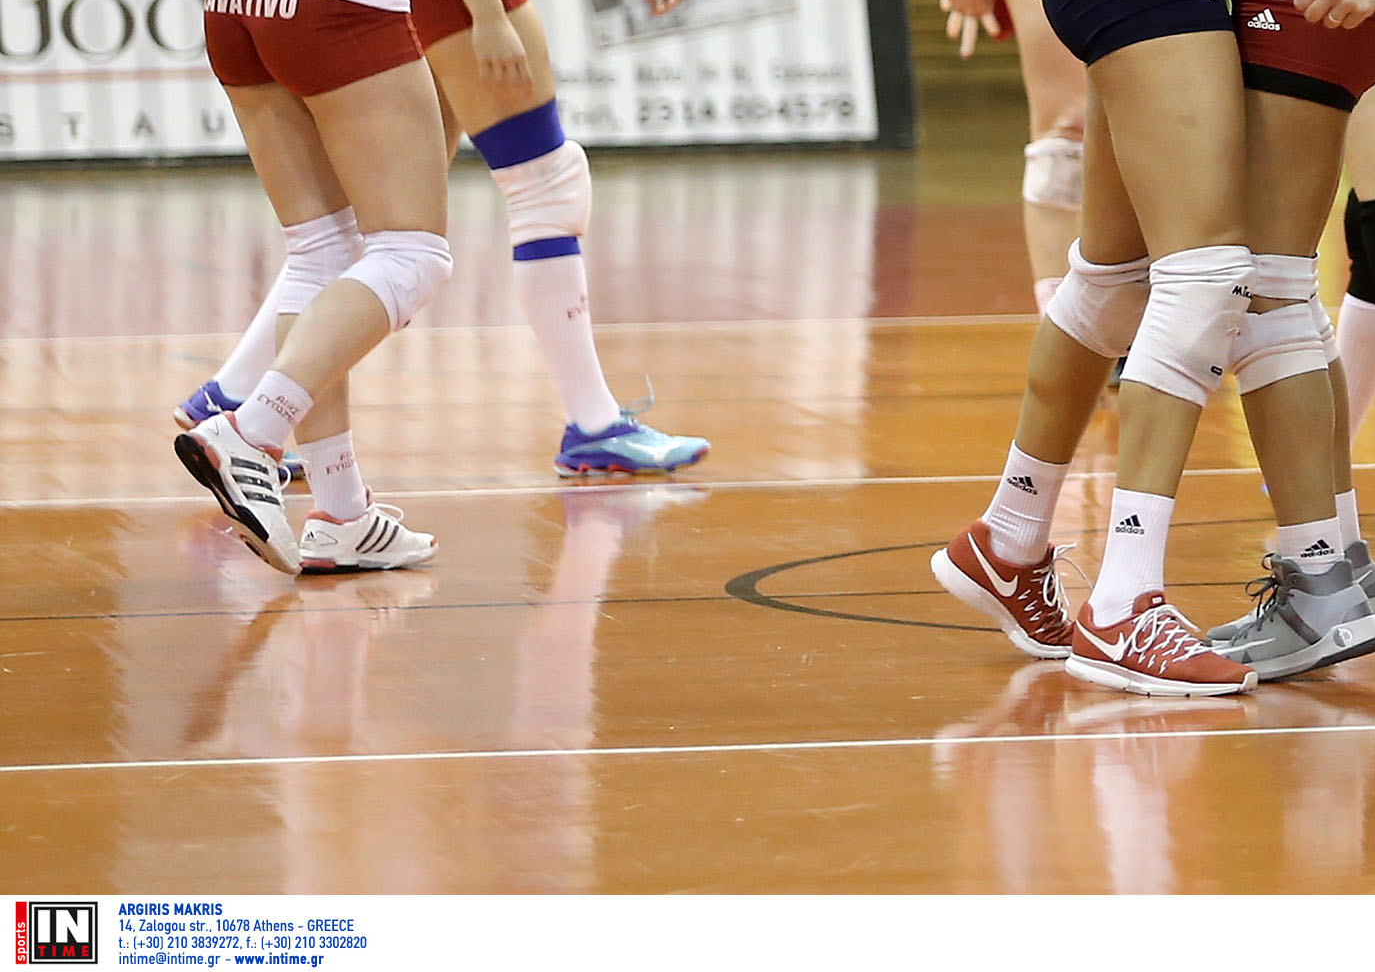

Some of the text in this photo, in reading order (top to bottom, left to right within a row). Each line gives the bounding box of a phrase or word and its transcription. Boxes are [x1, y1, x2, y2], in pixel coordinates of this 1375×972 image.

[1246, 18, 1281, 32] adidas
[1006, 478, 1039, 496] adidas
[1114, 525, 1145, 536] adidas
[1300, 548, 1336, 559] adidas
